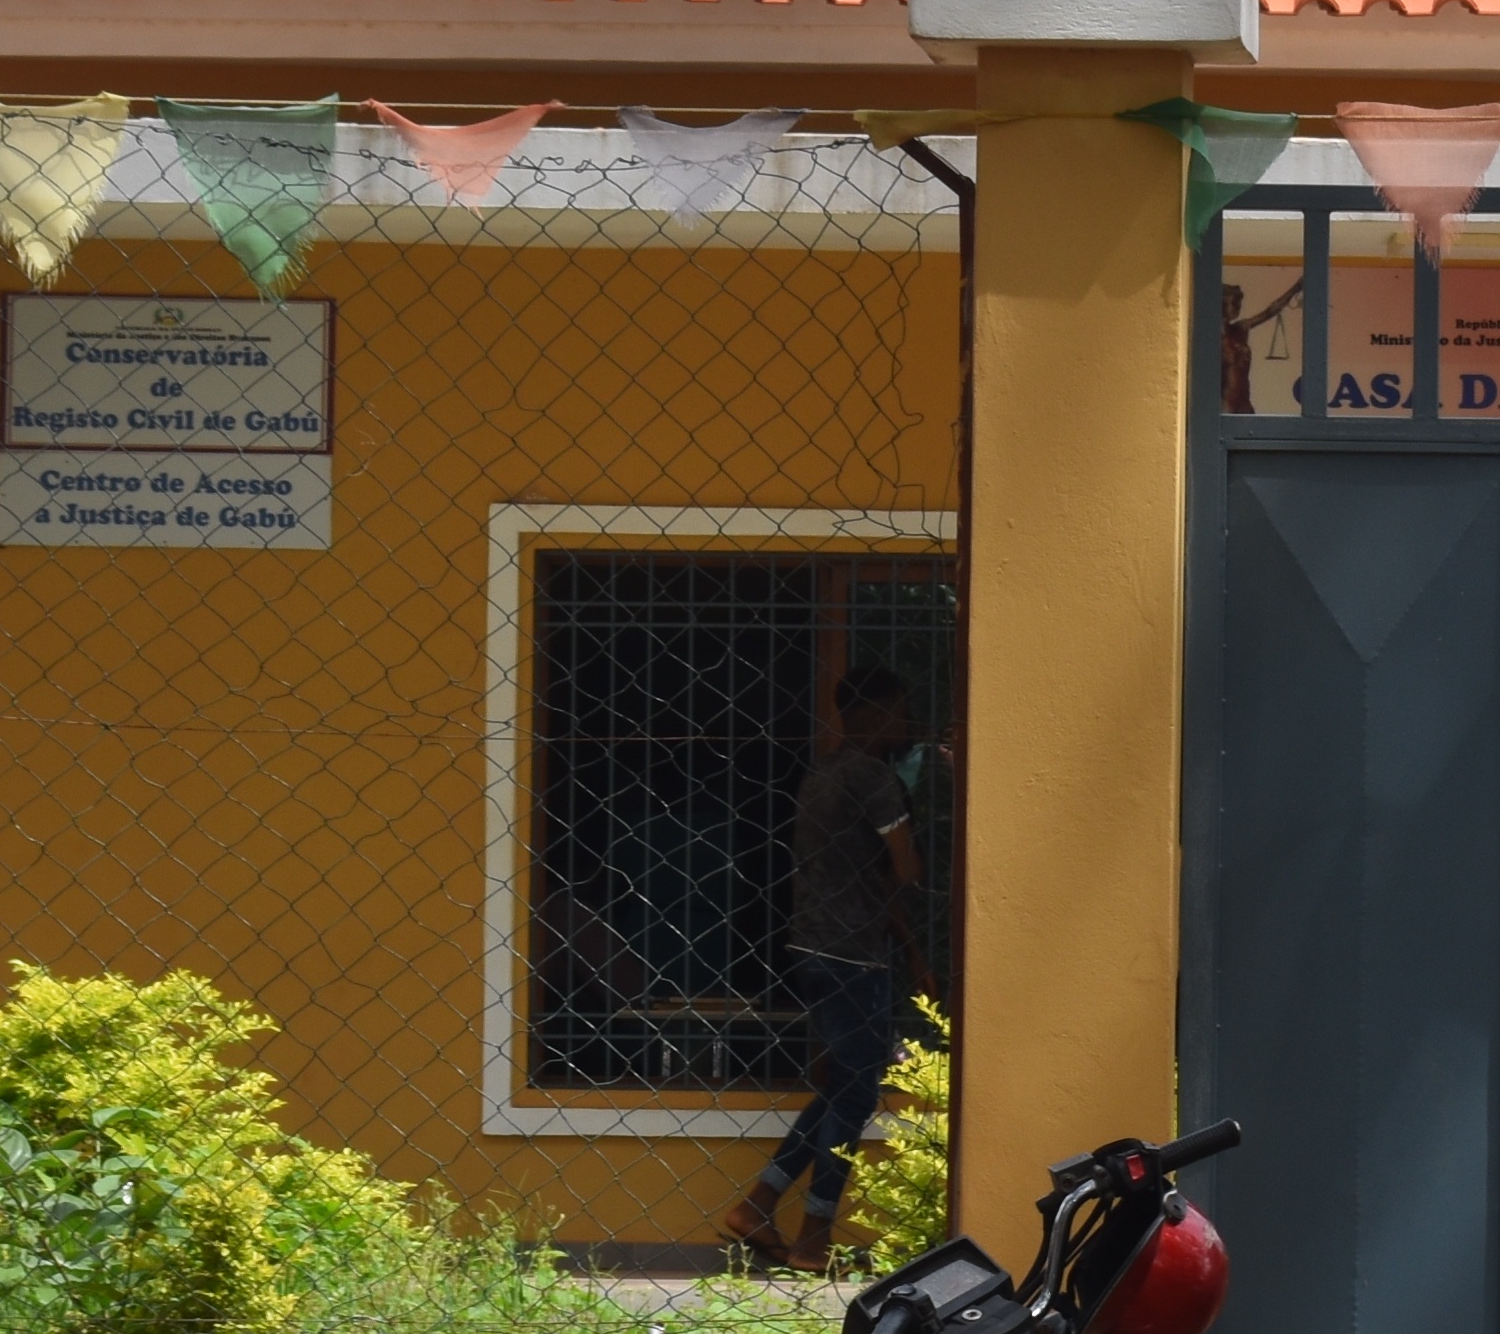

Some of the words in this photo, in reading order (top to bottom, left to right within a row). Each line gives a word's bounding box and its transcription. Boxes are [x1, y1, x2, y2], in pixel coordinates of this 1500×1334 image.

[1453, 335, 1472, 347] da
[65, 342, 269, 367] Conservatória
[150, 377, 184, 398] de
[13, 406, 119, 432] Registo
[127, 409, 195, 431] Civil
[202, 410, 236, 432] de
[244, 410, 319, 433] Gabú
[39, 470, 142, 493] Centro
[150, 472, 185, 493] de
[194, 474, 293, 496] Acesso
[35, 508, 51, 524] a
[59, 503, 167, 529] Justiça
[176, 506, 210, 527] de
